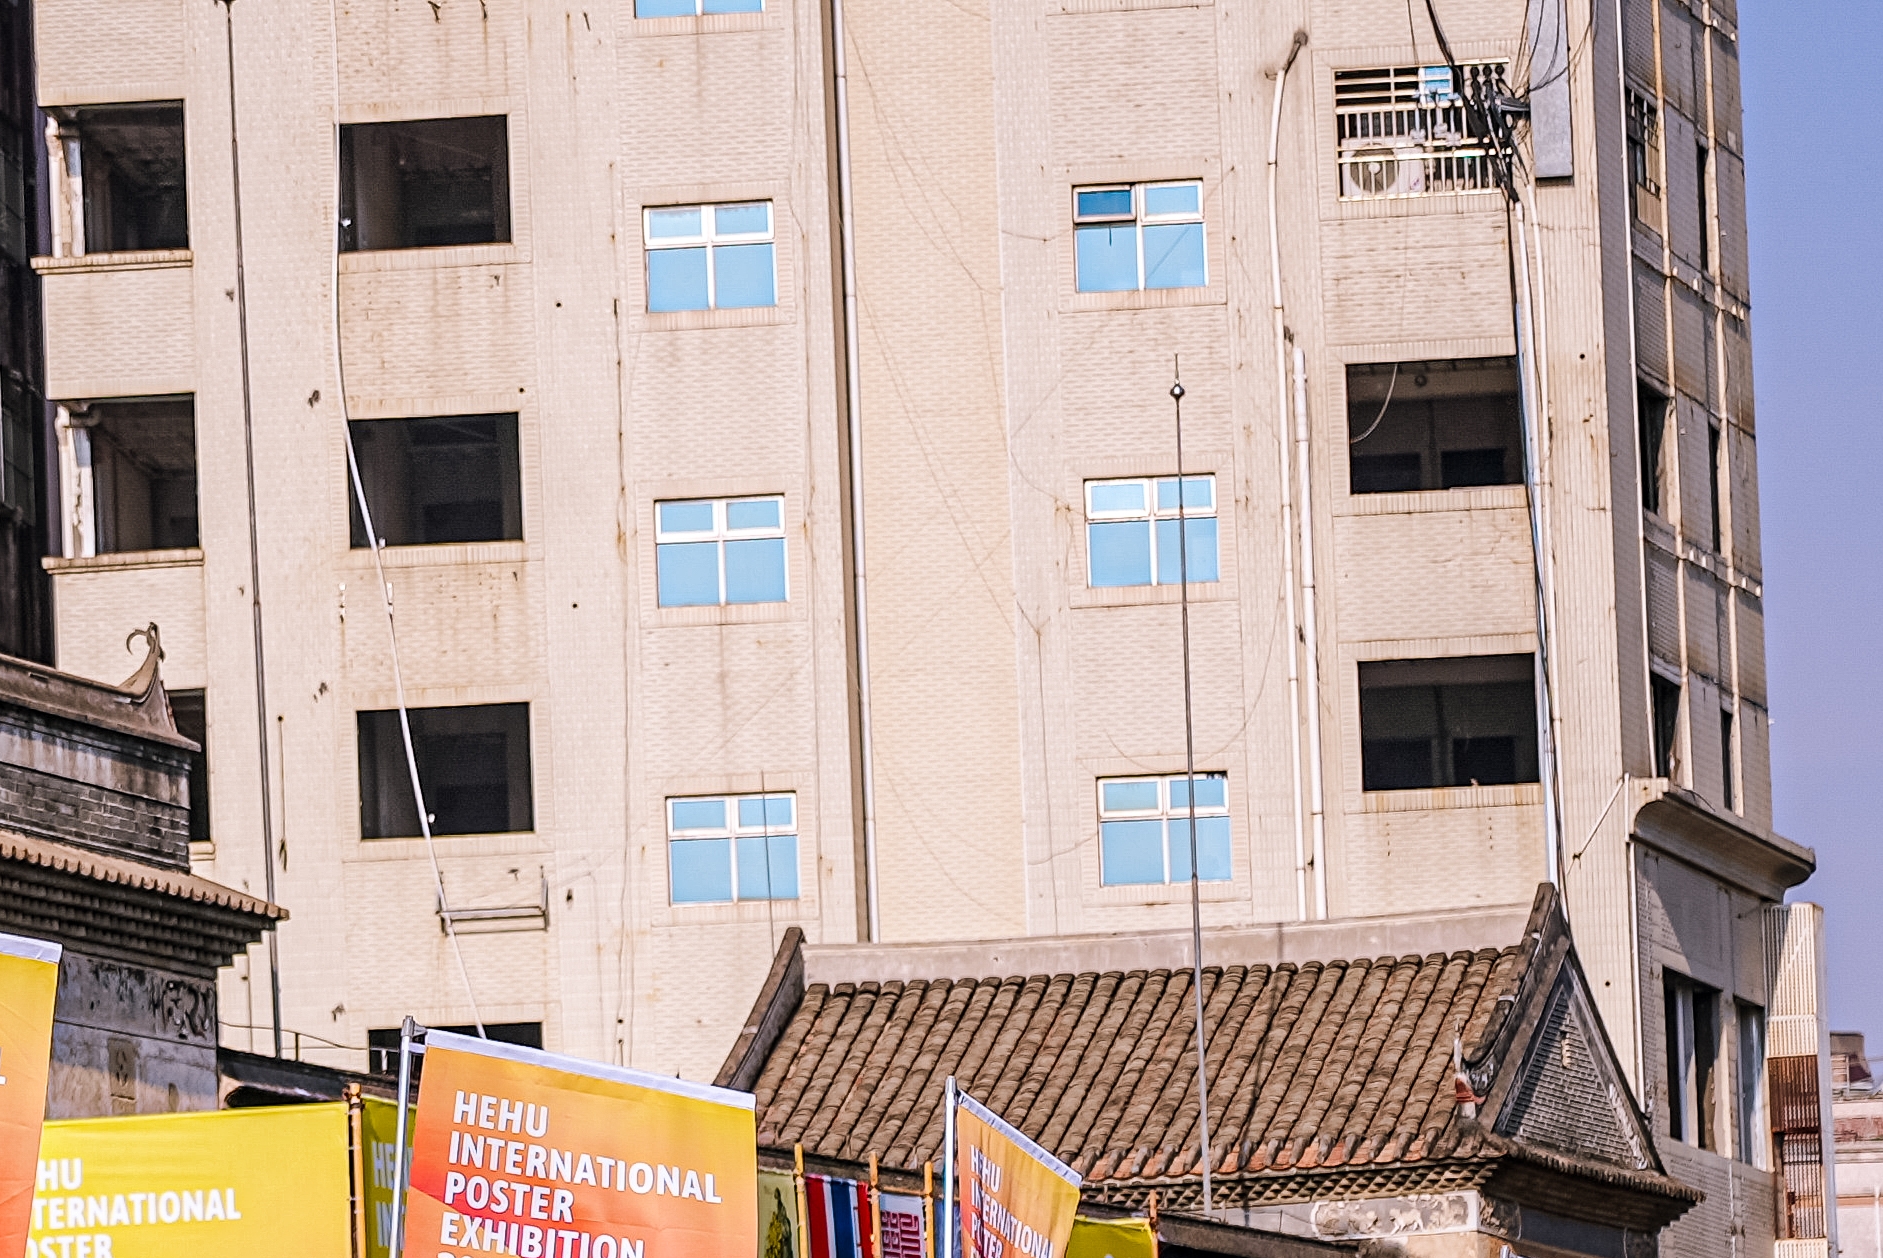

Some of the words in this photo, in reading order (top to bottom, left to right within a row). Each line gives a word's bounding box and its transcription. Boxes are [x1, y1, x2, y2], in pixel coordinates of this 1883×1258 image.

[453, 1090, 549, 1138] HEHU
[37, 1157, 82, 1191] HU
[448, 1131, 722, 1204] INTERNATIONAL
[32, 1188, 241, 1231] TERNATIONAL
[445, 1172, 574, 1223] POSTER
